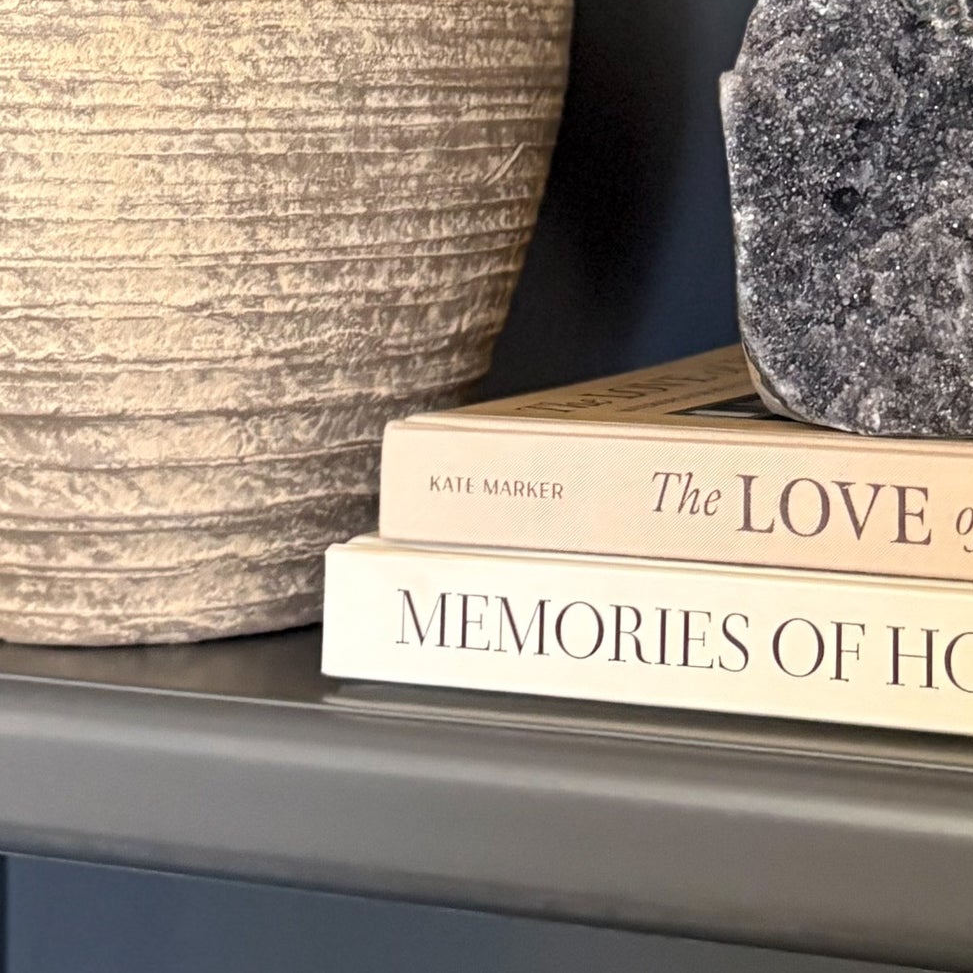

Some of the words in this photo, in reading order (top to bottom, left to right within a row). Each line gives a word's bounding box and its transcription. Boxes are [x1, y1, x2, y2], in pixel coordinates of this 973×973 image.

[428, 474, 476, 495] KATE
[483, 477, 565, 500] MARKER
[651, 471, 722, 517] The
[735, 473, 932, 546] LOVE
[395, 588, 750, 673] MEMORIES
[771, 617, 866, 683] OF
